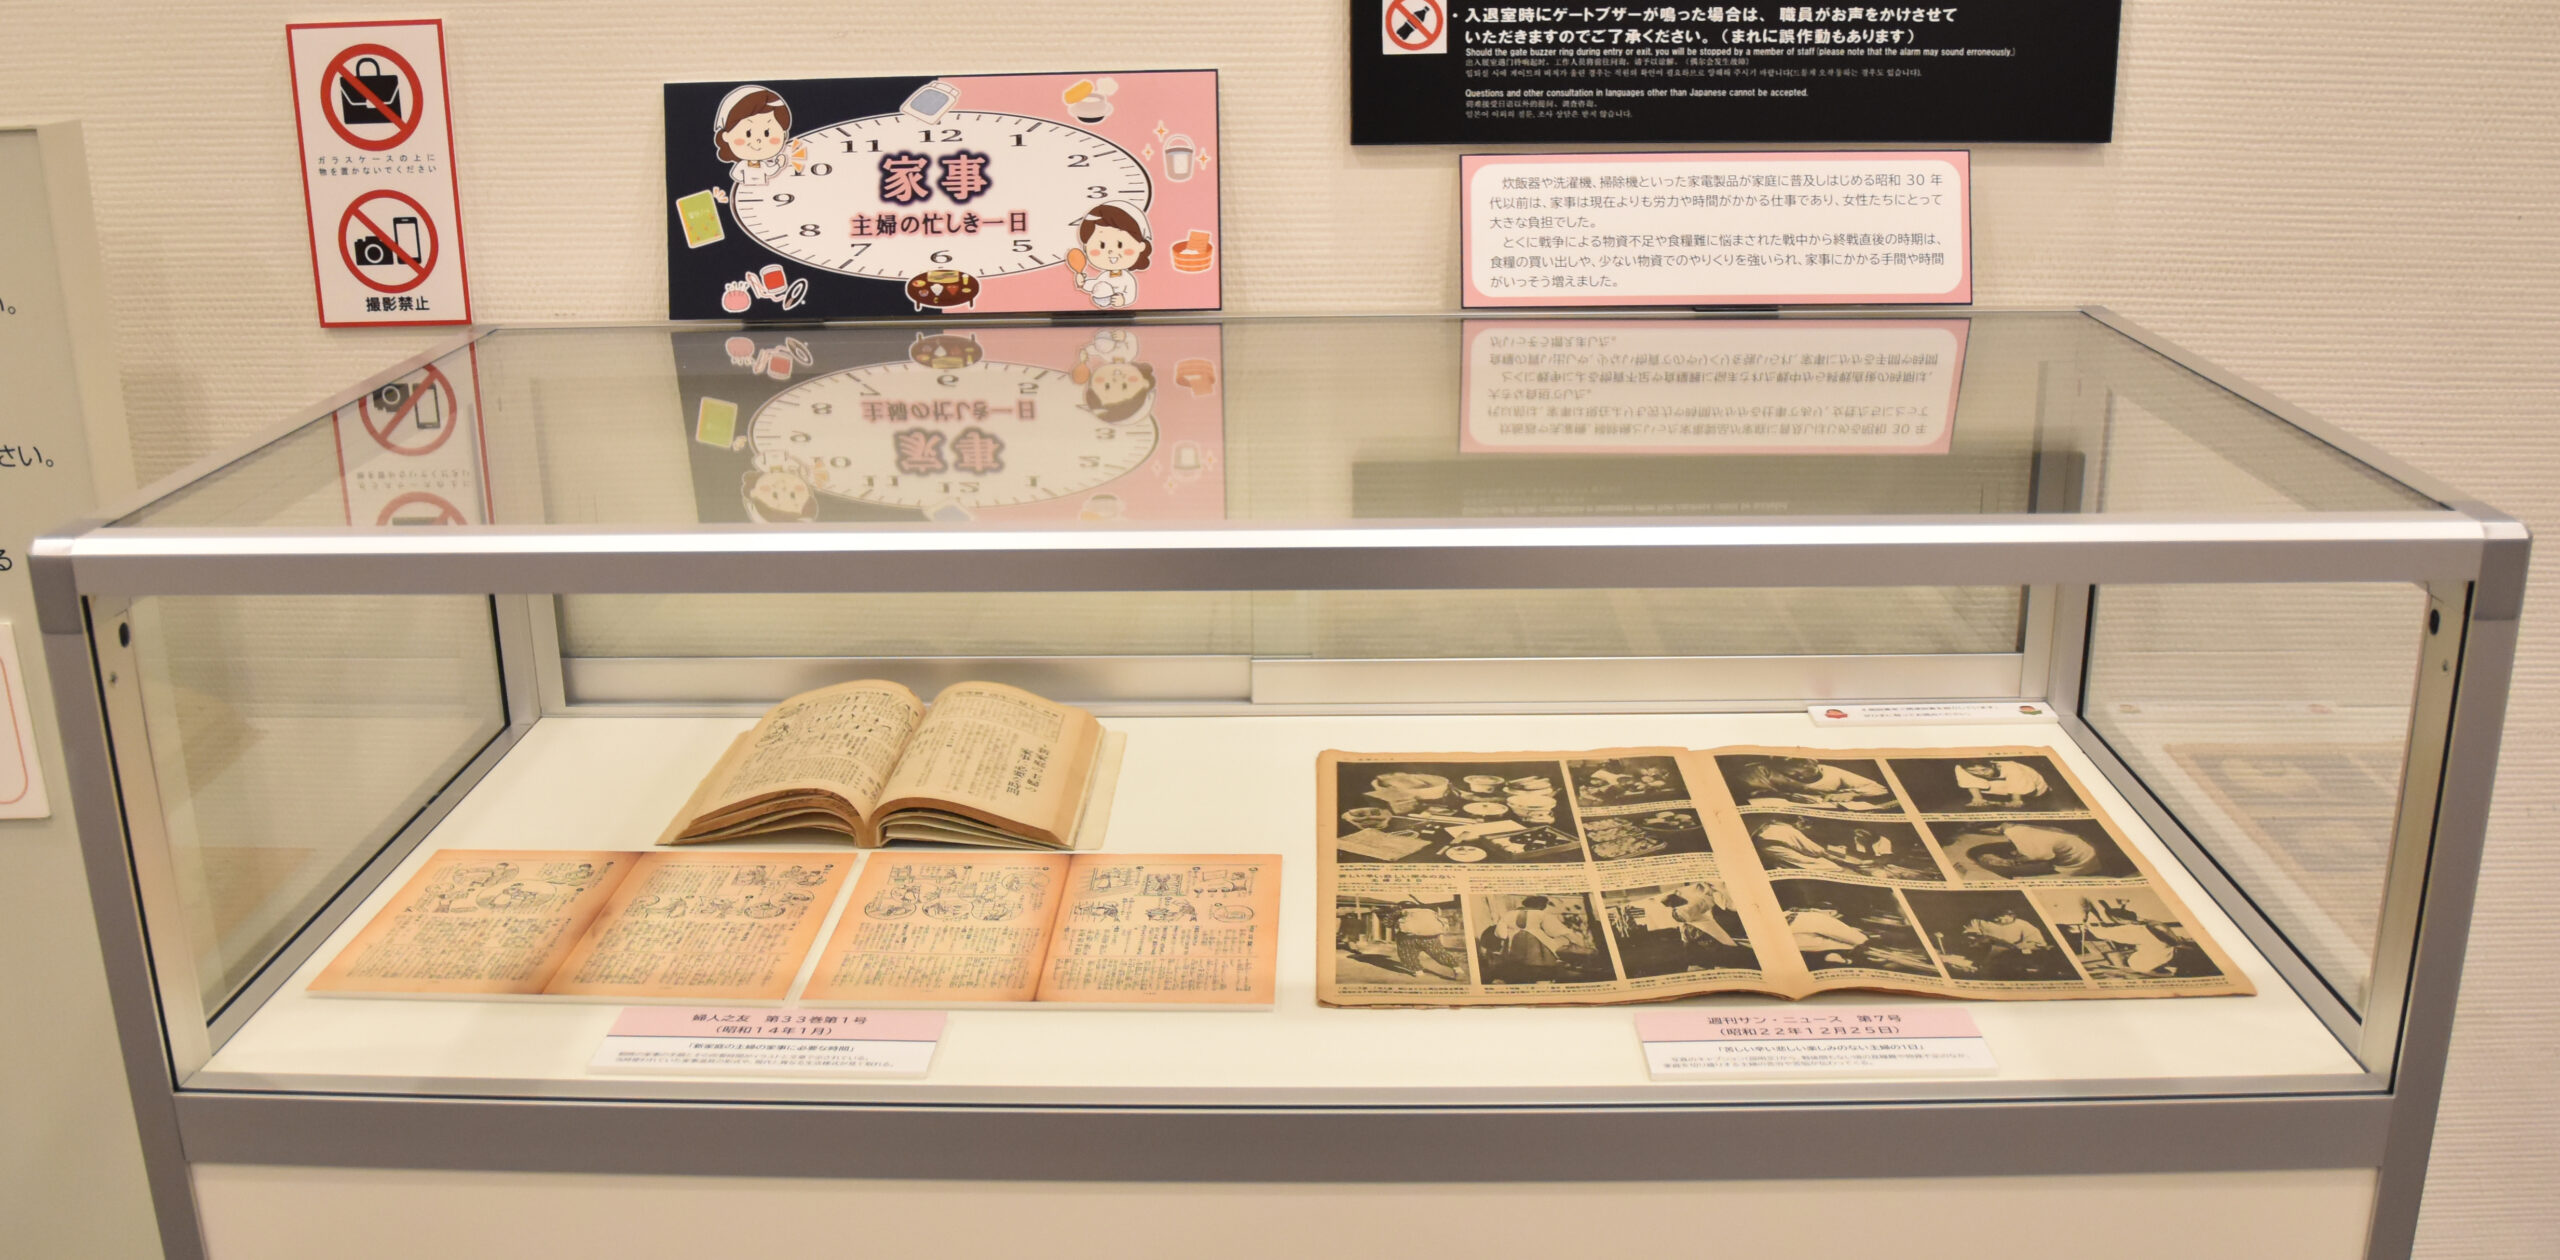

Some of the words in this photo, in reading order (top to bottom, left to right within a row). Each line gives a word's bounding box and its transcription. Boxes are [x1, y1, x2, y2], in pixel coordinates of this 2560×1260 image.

[1465, 47, 1493, 57] Should
[1494, 47, 1508, 57] the
[1509, 47, 1528, 57] gate
[1529, 47, 1557, 57] buzzer
[1558, 47, 1575, 57] ring
[1575, 47, 1601, 57] during
[1602, 47, 1624, 57] entry
[1625, 47, 1634, 57] or
[1654, 47, 1670, 57] you
[1671, 47, 1685, 57] will
[1686, 47, 1698, 57] be
[1699, 47, 1732, 57] stopped
[1733, 47, 1744, 57] by
[1745, 47, 1752, 57] a
[1752, 47, 1785, 57] member
[1786, 47, 1795, 57] of
[1796, 47, 1816, 57] staff
[1846, 47, 1865, 57] note
[1866, 47, 1883, 57] that
[1884, 47, 1898, 57] the
[1899, 47, 1922, 57] alarm
[1922, 47, 1939, 57] may
[1940, 47, 1965, 57] sound
[1465, 88, 1505, 98] Questions
[1506, 88, 1522, 98] and
[1523, 88, 1545, 98] other
[1546, 88, 1594, 98] consultation
[1595, 88, 1604, 98] in
[1605, 88, 1645, 98] languages
[1646, 88, 1668, 98] other
[1669, 88, 1688, 98] than
[1689, 88, 1727, 98] Japanese
[1728, 88, 1756, 98] cannot
[1757, 88, 1769, 98] be
[1770, 88, 1809, 98] accepted.
[918, 129, 963, 143] 12
[1009, 134, 1028, 147] 1
[841, 139, 883, 153] 11
[1067, 154, 1090, 168] 2
[318, 165, 437, 176] 物を置かないでください
[881, 151, 991, 204] 家事
[1906, 174, 1925, 186] 30
[1086, 185, 1108, 199] 3
[772, 193, 795, 207] 9
[851, 211, 1028, 237] 主婦の忙しき一日
[1489, 215, 1598, 229] 大きな負担でした。
[799, 223, 821, 238] 8
[851, 243, 872, 257] 7
[1012, 239, 1033, 253] 5
[930, 249, 953, 264] 6
[1490, 274, 1619, 289] がいっそう増えました。
[365, 296, 430, 313] 撮影禁止
